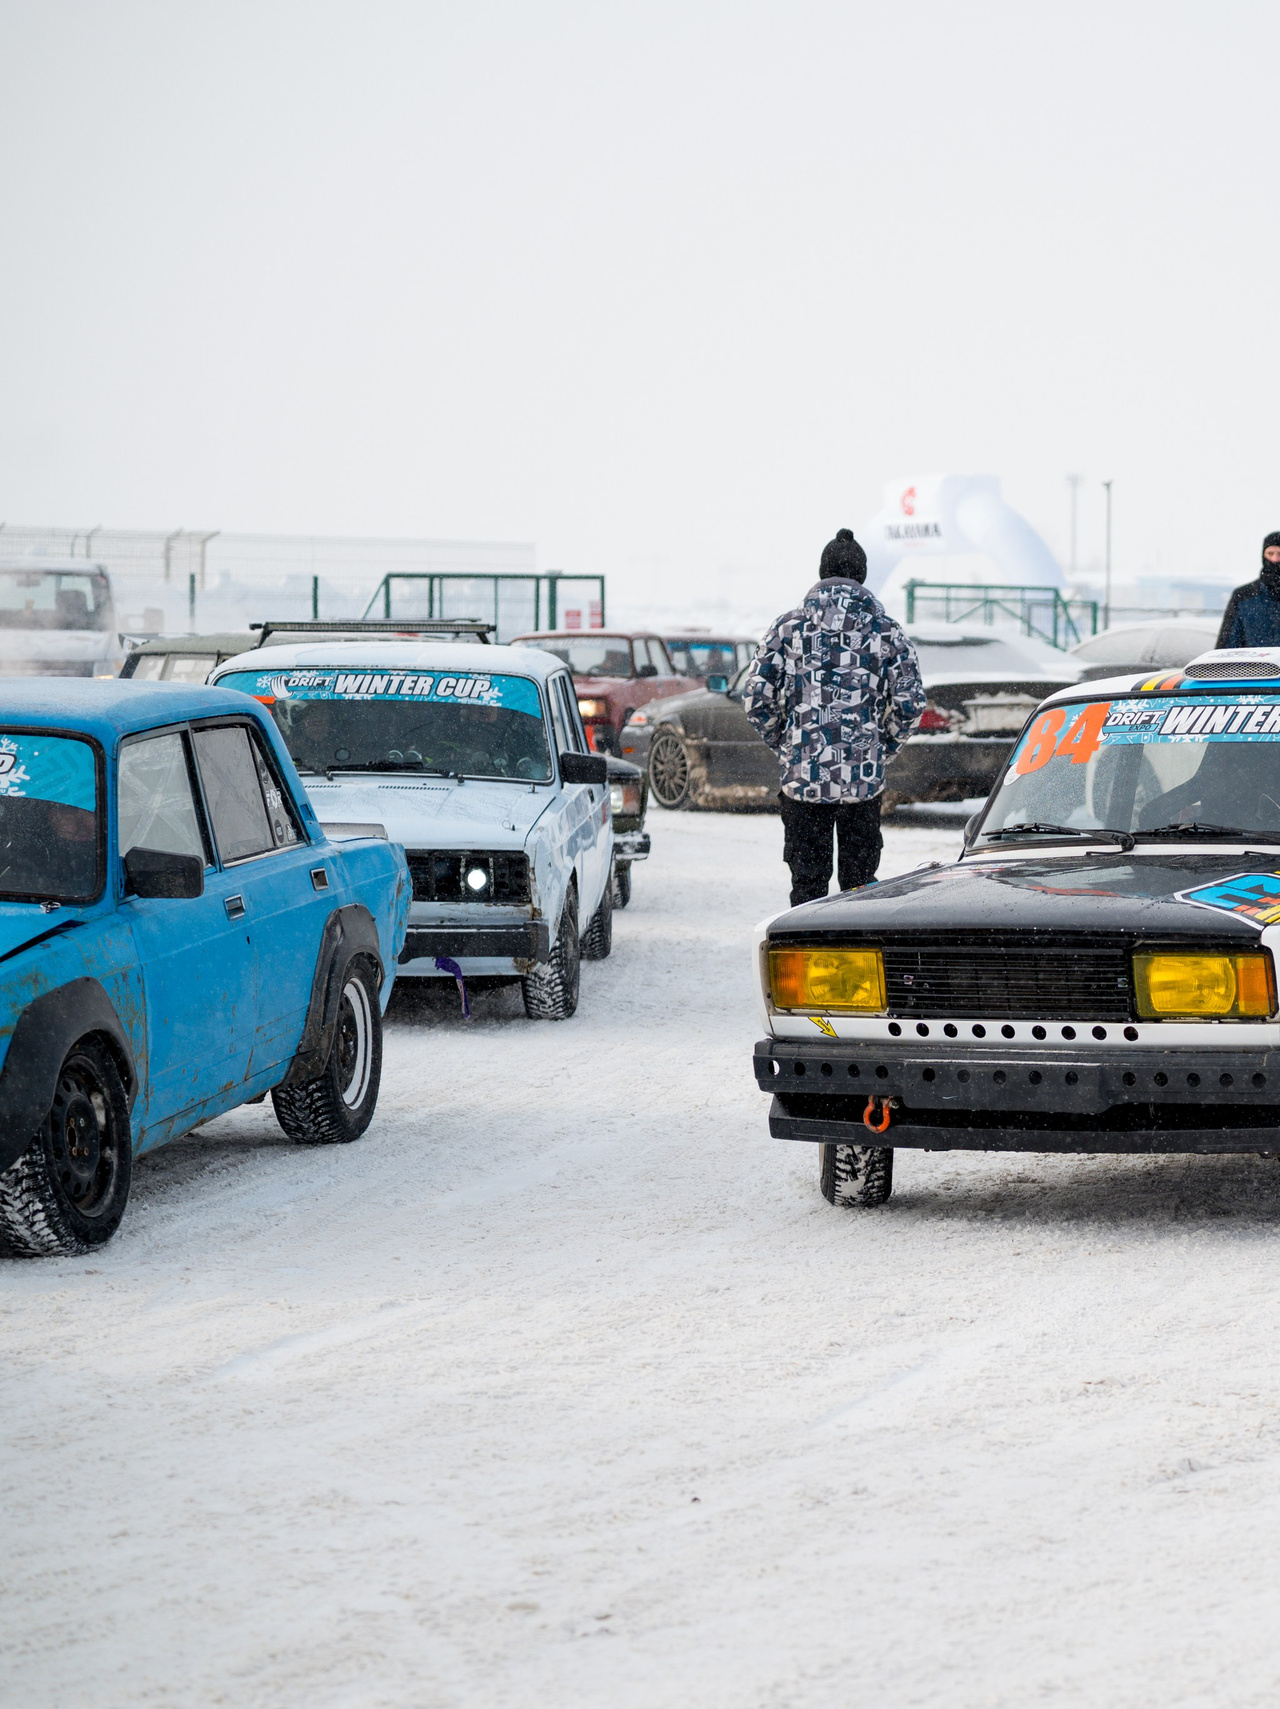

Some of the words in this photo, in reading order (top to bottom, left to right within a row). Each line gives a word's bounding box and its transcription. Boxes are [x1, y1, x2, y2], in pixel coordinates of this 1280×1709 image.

[287, 676, 335, 687] DRIFT
[333, 673, 435, 697] WINTER
[435, 677, 491, 699] CUP
[1106, 710, 1167, 726] DRIFT
[1128, 724, 1152, 732] EXPO
[1016, 702, 1112, 775] 84
